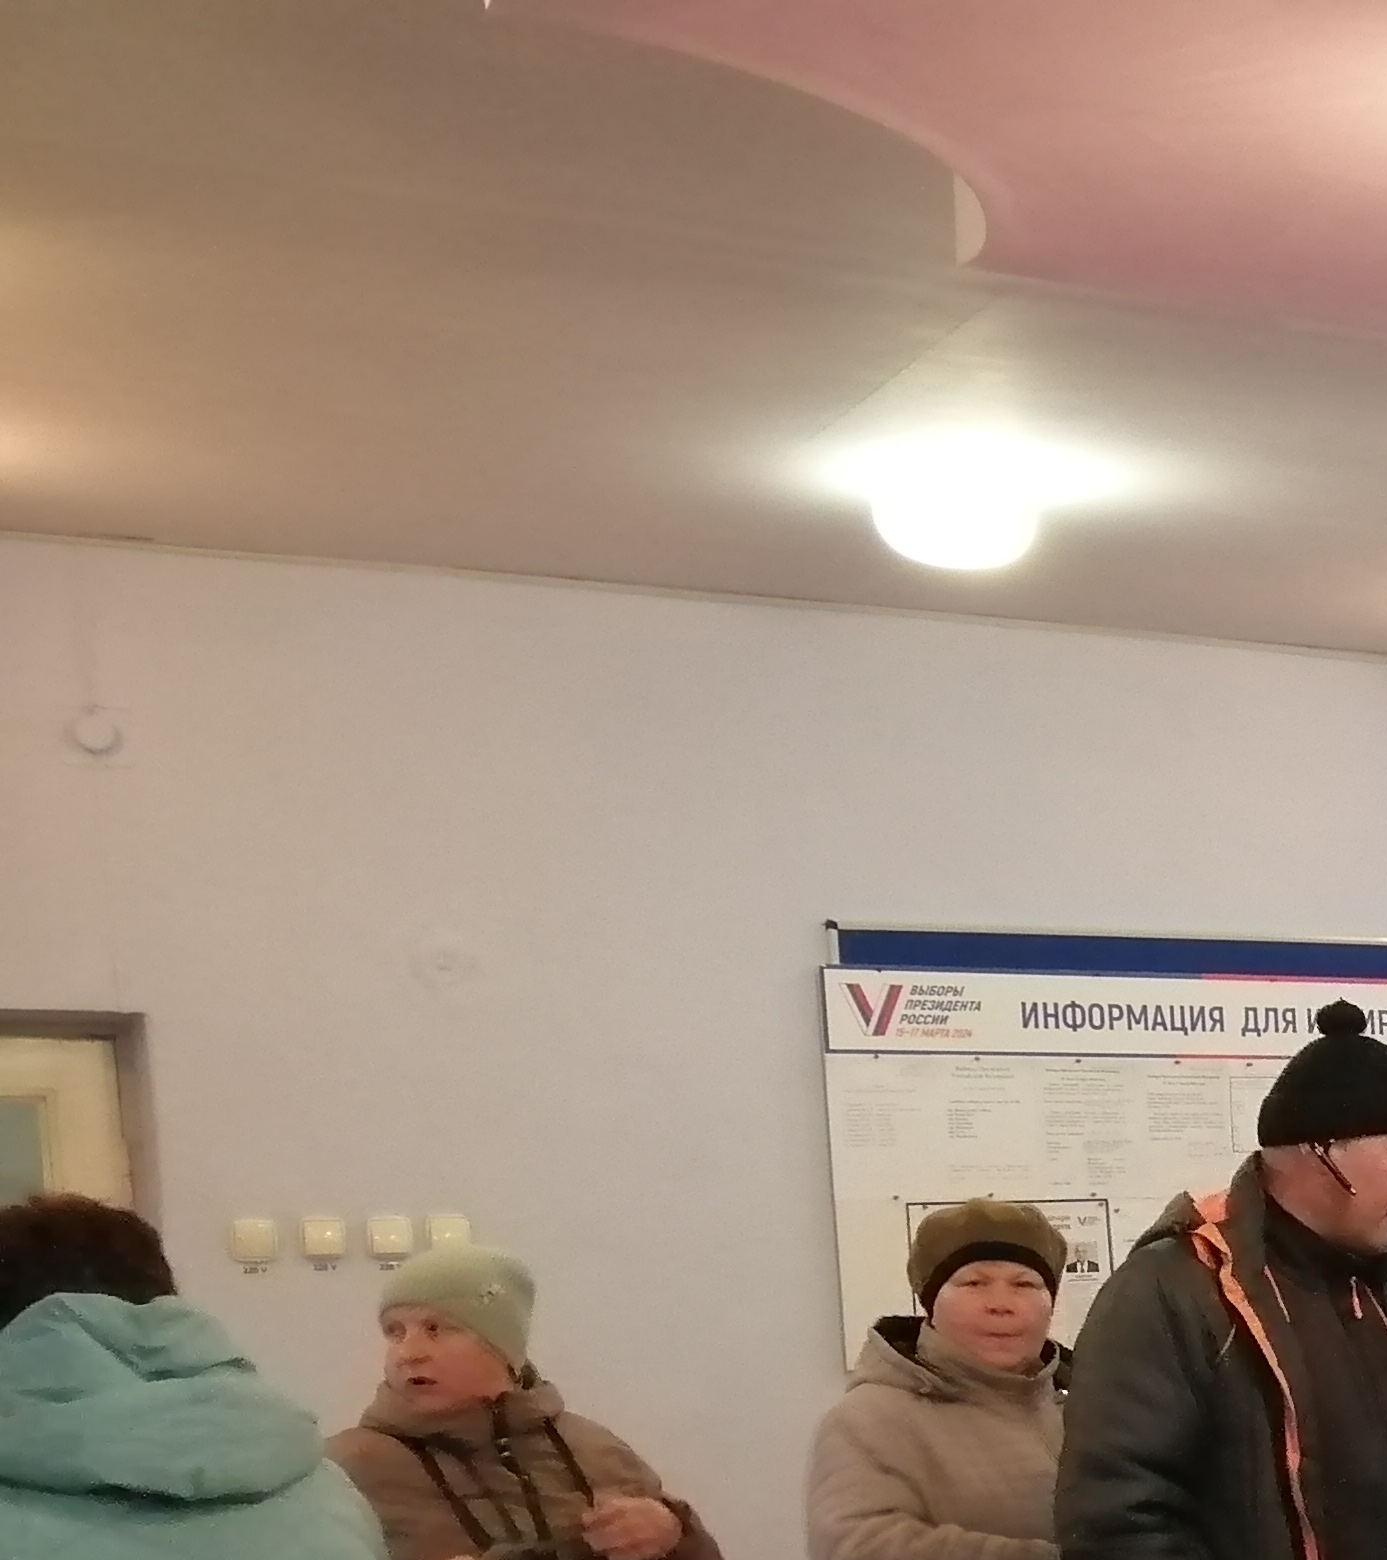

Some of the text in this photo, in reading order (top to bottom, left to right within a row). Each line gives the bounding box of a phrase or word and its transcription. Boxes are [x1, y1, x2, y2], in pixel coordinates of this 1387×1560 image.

[910, 985, 965, 997] ВЫБОРЫ
[904, 999, 982, 1012] ПРЕЗИДЕНТА
[899, 1013, 950, 1025] РОССИИ
[1020, 1001, 1226, 1036] ИНФОРМАЦИЯ
[1241, 1007, 1297, 1037] ДЛЯ
[921, 1028, 950, 1038] МАРТА
